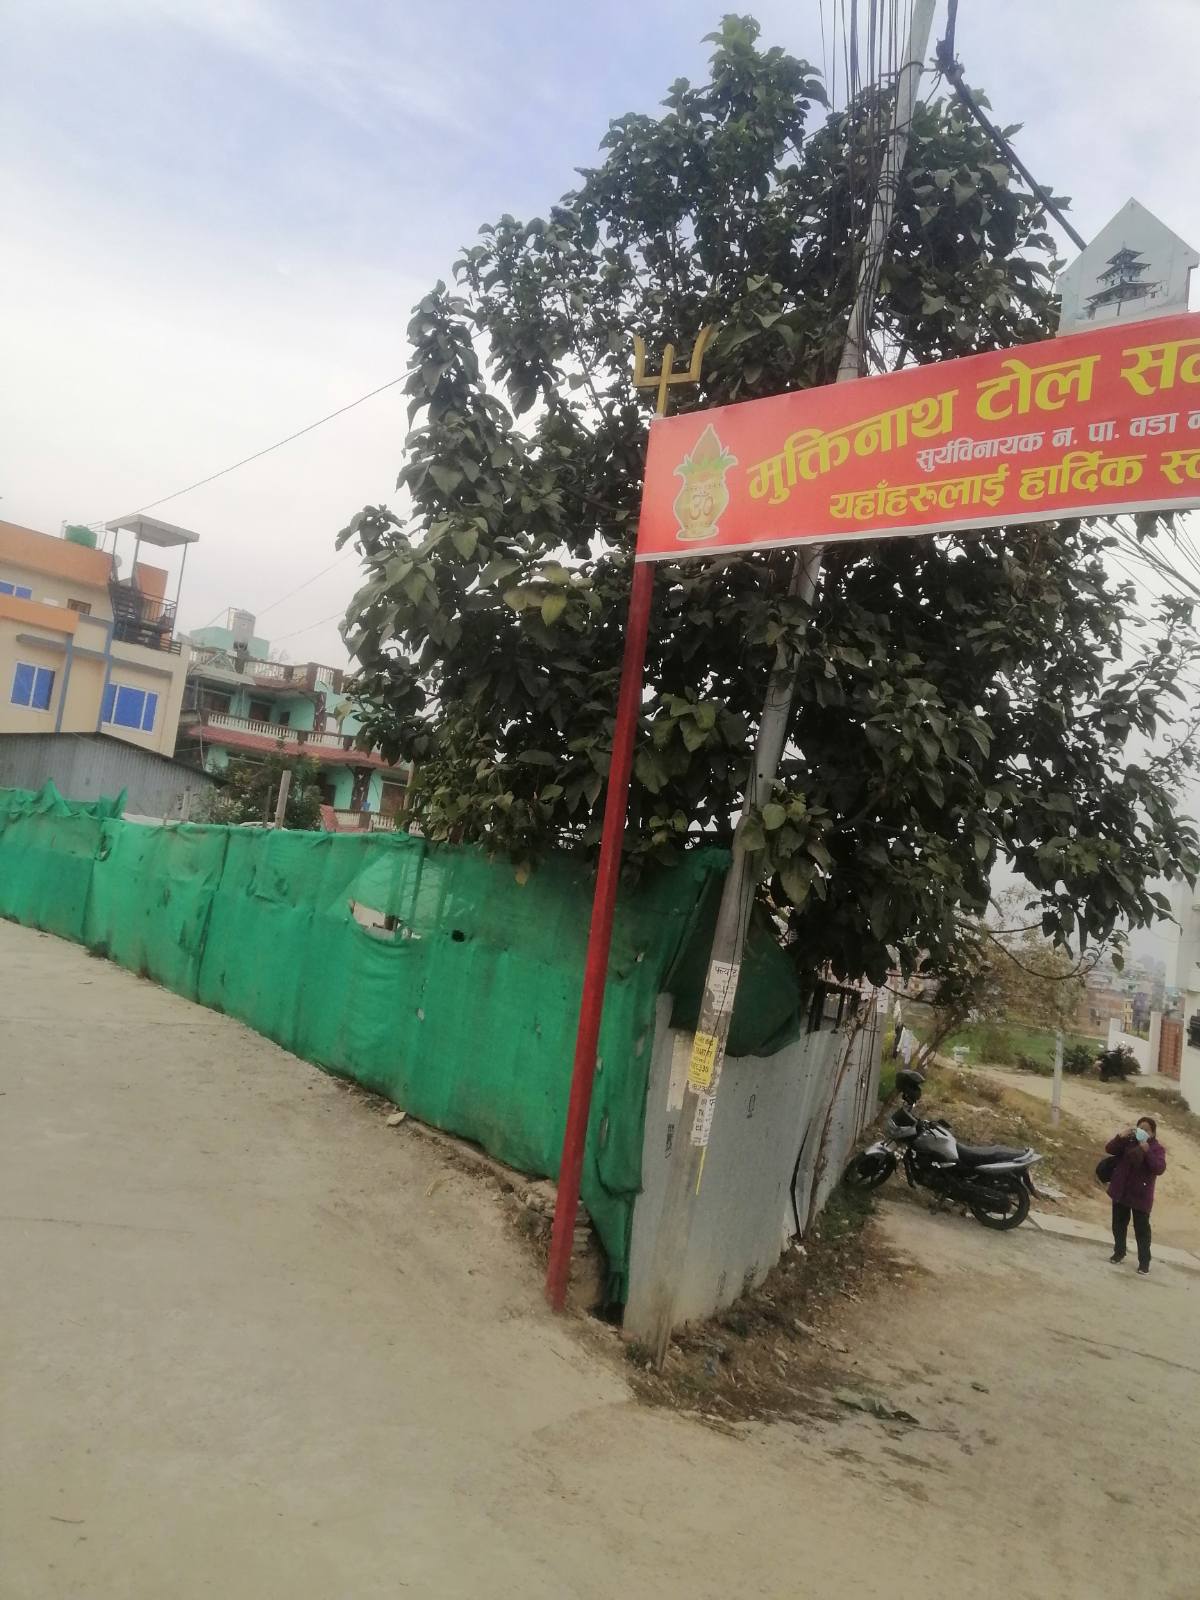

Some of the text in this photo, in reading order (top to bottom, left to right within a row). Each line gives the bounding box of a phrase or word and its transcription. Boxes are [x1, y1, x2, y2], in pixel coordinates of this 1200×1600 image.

[746, 388, 960, 505] मुक्तिनाथ
[976, 354, 1102, 421] टोल
[1088, 421, 1120, 443] पा.
[1129, 412, 1180, 438] वडा
[1019, 449, 1148, 502] हार्दिक
